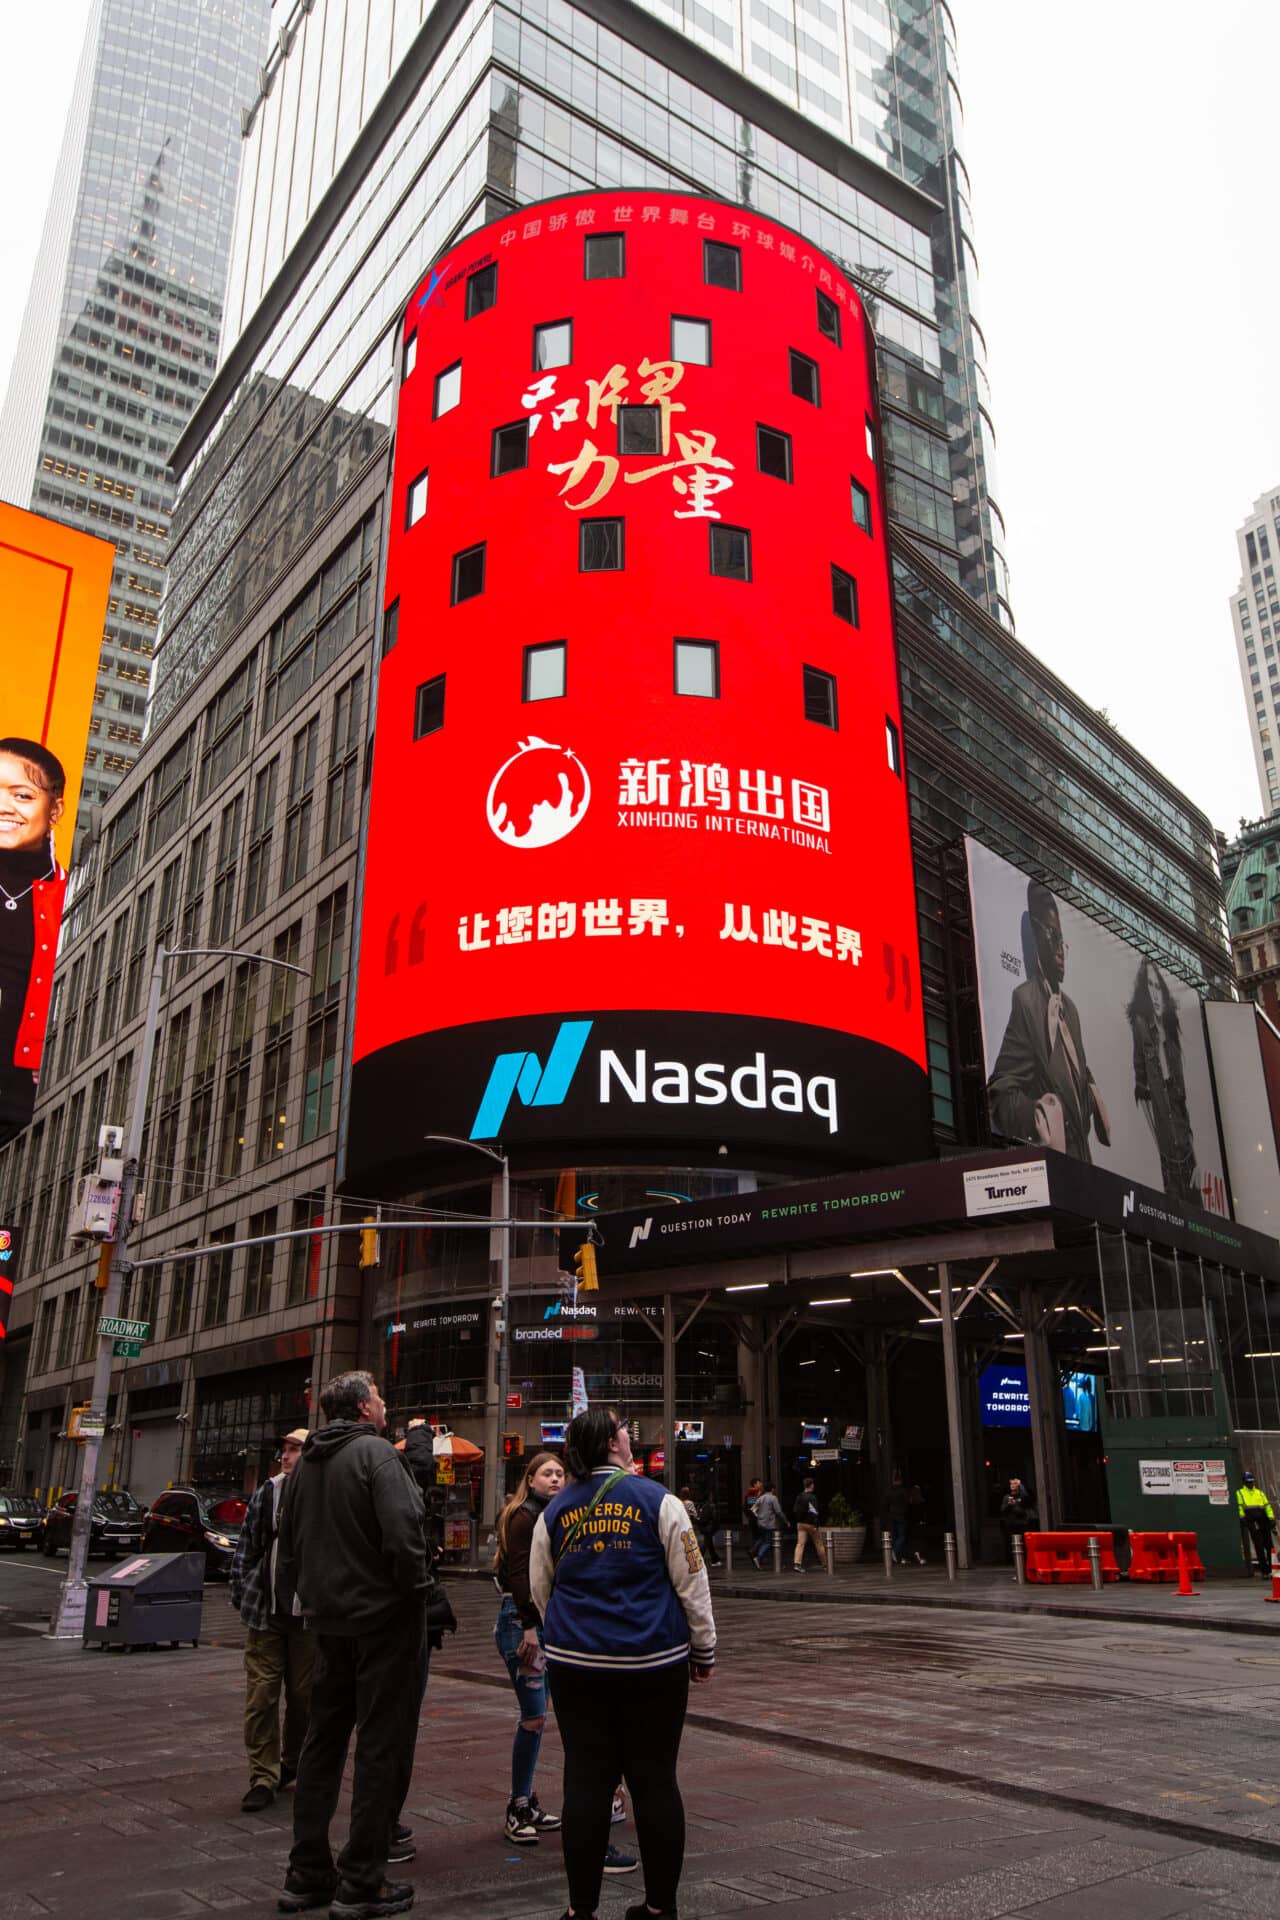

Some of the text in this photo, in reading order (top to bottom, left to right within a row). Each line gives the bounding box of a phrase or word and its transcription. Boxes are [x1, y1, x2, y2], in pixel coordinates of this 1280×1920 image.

[500, 208, 596, 247] 中国骄傲
[613, 206, 715, 231] 世界舞台
[521, 357, 686, 456] 品牌
[547, 430, 736, 519] 力量
[618, 758, 831, 833] 新鸿出国
[617, 811, 833, 855] XINHONG INTERNATIONAL
[719, 902, 863, 966] 从此无界
[599, 1049, 838, 1134] Nasdaq
[985, 1185, 1027, 1200] Turner
[660, 1217, 713, 1234] QUESTION
[717, 1212, 752, 1225] TODAY
[761, 1202, 819, 1219] REWRITE
[560, 1305, 597, 1317] Nasdaq
[614, 1306, 656, 1316] REWTE
[116, 1342, 130, 1356] 43
[611, 1373, 663, 1388] Nasdaq
[986, 1403, 1031, 1412] TOMORRO
[992, 1392, 1030, 1401] REWRITE
[681, 1527, 697, 1553] 19
[685, 1550, 703, 1574] 12
